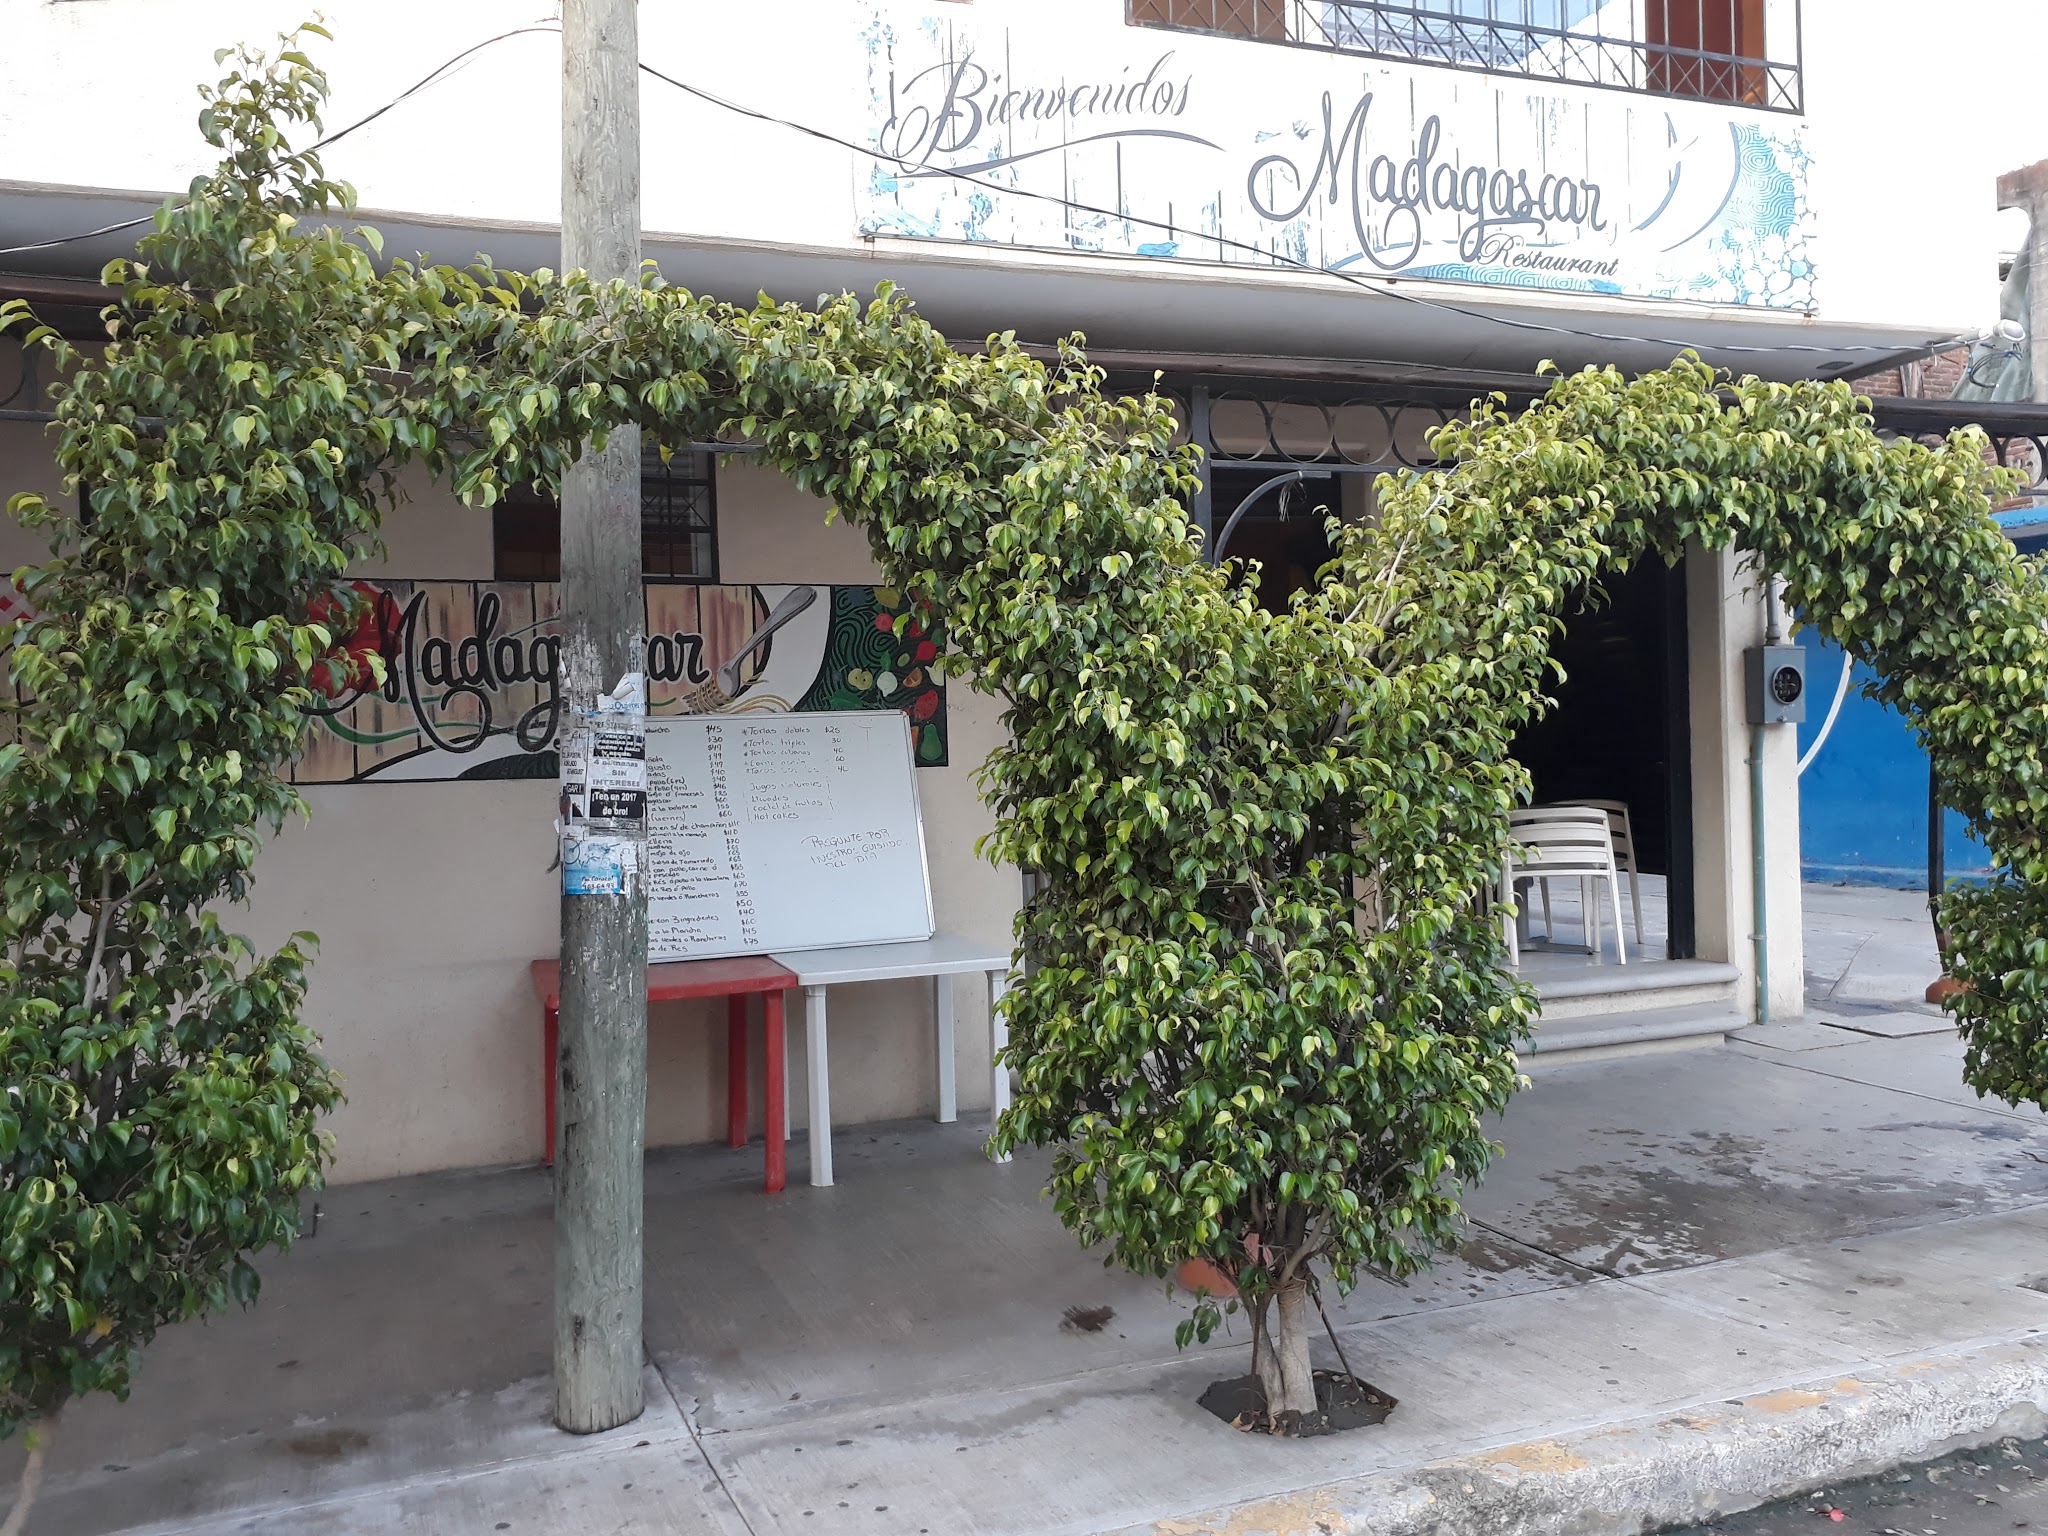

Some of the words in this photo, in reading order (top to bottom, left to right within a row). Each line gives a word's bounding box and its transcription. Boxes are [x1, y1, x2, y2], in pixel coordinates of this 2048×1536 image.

[880, 50, 1192, 173] Bienvenidos
[1247, 91, 1606, 270] Madagascar
[1481, 233, 1618, 287] Restaurant
[296, 588, 710, 755] Madagar
[706, 725, 722, 735] $45
[785, 726, 811, 734] dobles
[833, 746, 844, 754] 40
[592, 778, 641, 787] INTERESES
[749, 782, 777, 792] Jugos
[611, 793, 620, 801] un
[621, 793, 637, 802] 2017
[602, 807, 611, 815] de
[754, 811, 769, 820] Hot
[801, 834, 863, 849] PREGUNTE
[866, 828, 890, 840] POR
[736, 899, 753, 908] $50
[744, 937, 759, 945] $75
